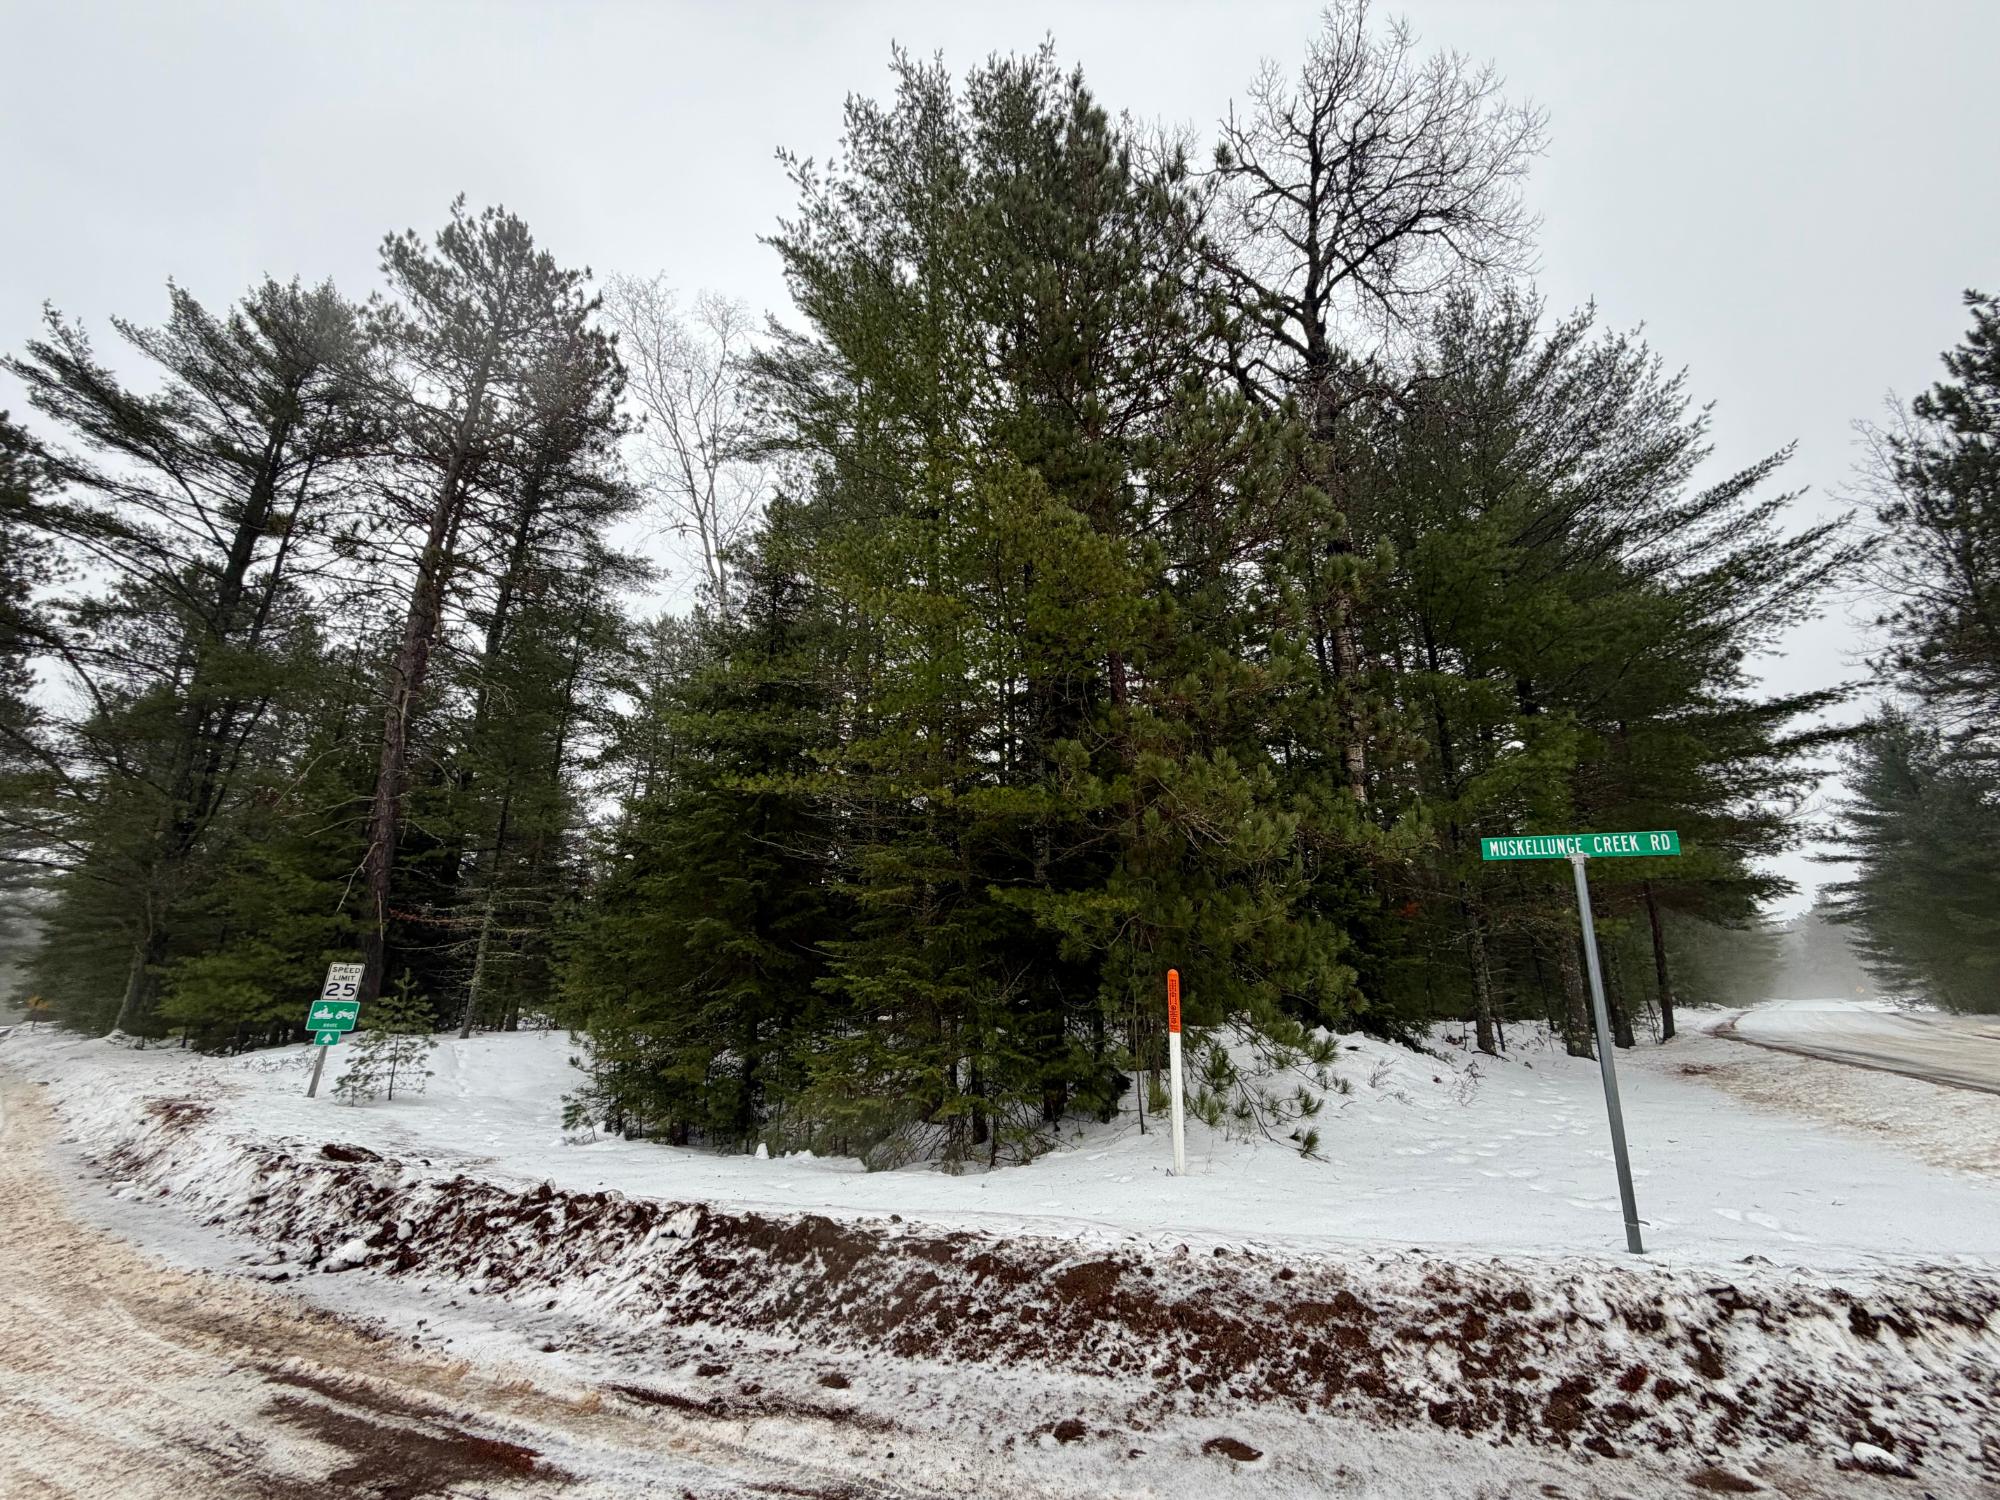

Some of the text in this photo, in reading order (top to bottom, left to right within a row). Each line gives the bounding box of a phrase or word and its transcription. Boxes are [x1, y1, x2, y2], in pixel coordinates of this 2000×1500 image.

[1489, 833, 1671, 856] MUSKELLUNGE CREEK RD
[332, 966, 361, 974] SPEED
[325, 982, 356, 997] 25
